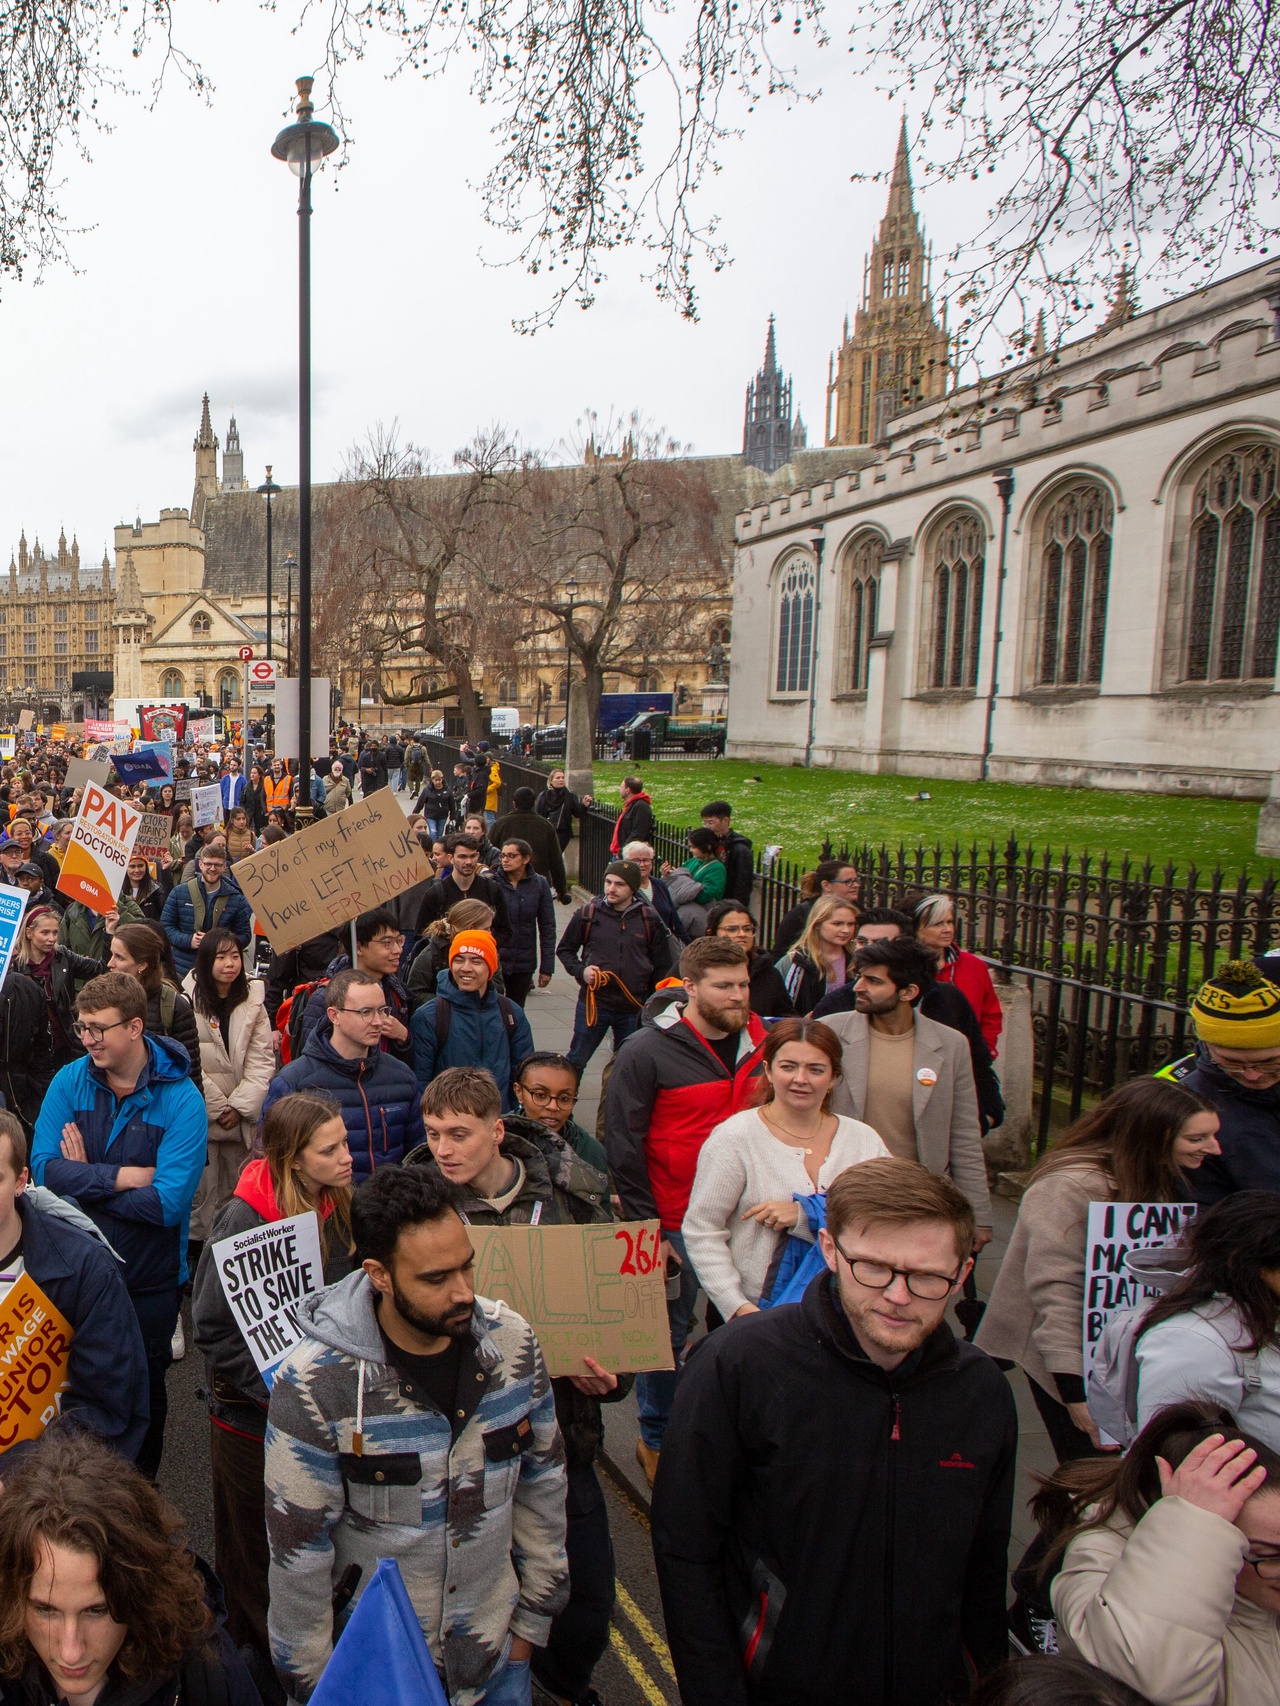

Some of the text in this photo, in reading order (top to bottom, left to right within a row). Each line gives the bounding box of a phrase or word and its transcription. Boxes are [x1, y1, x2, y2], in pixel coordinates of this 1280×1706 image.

[242, 649, 250, 660] P
[81, 786, 138, 842] PAY
[75, 826, 128, 868] DOCTORS
[79, 818, 130, 854] RESTORATION FOR
[238, 802, 382, 898] 30% of my friends
[85, 882, 99, 897] BMA
[263, 829, 420, 930] have LEFT the UK
[327, 862, 419, 922] FPR NOW
[468, 946, 485, 957] BMA
[233, 1224, 296, 1252] Socialist Worker
[1103, 1204, 1197, 1240] I CAN'T
[222, 1234, 300, 1293] STRIKE
[473, 1226, 662, 1325] ALE 26%
[12, 1291, 36, 1322] IS
[231, 1287, 264, 1327] TO
[262, 1262, 316, 1312] SAVE
[624, 1278, 666, 1320] OFF
[1088, 1276, 1140, 1309] FLAT
[1, 1306, 47, 1365] WAGE
[246, 1314, 294, 1362] THE
[539, 1330, 657, 1346] OCTOR NOW
[630, 1354, 660, 1365] HOUR
